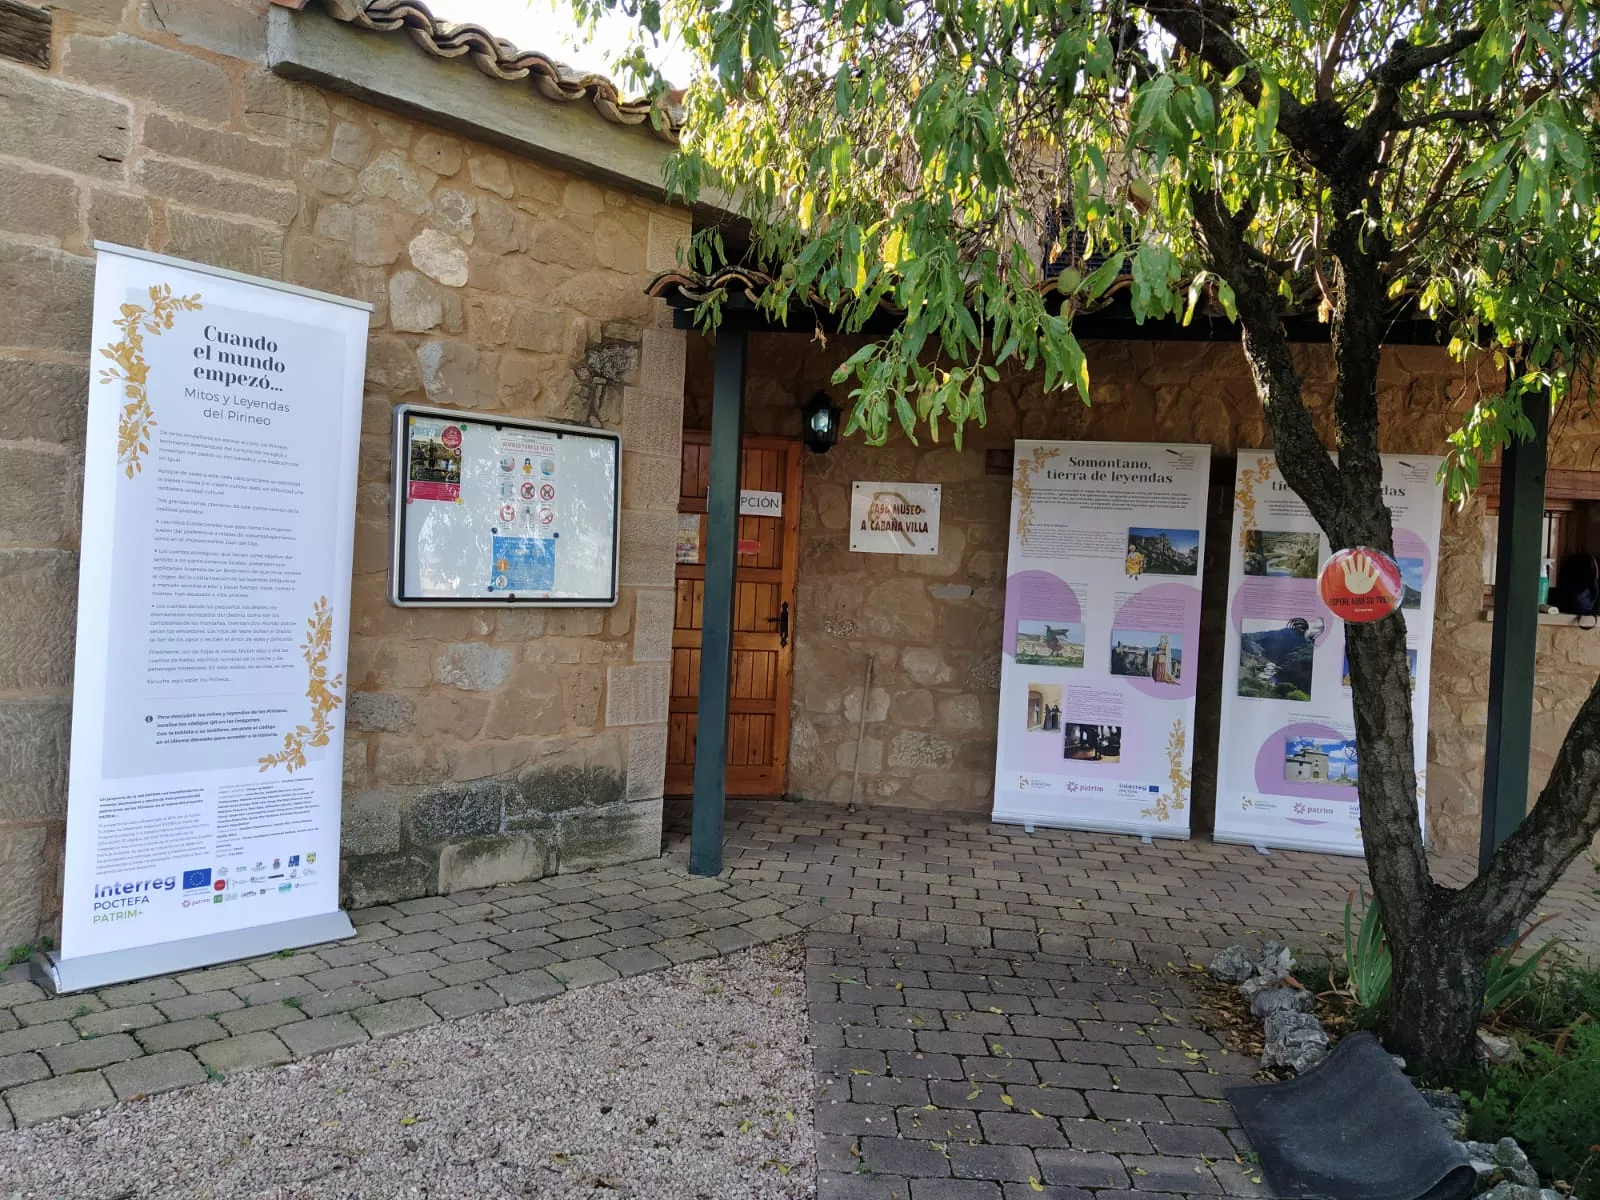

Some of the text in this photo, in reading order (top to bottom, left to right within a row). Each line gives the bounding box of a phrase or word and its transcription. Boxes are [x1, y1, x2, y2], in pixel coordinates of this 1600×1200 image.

[204, 325, 277, 352] Cuando
[194, 345, 285, 373] el mundo
[194, 366, 283, 391] empezó...
[185, 388, 290, 412] Mitos y Leyendas
[204, 408, 270, 425] del Pirineo
[1047, 470, 1173, 484] tierra de leyendas
[740, 496, 778, 508] PCIÓN
[871, 504, 921, 515] CASA MUSEO
[861, 518, 928, 533] A CABAÑA VILLA
[1307, 806, 1334, 814] patrim
[94, 876, 176, 898] Interreg
[94, 896, 150, 910] POCTEFA
[93, 910, 143, 924] PATRIM+
